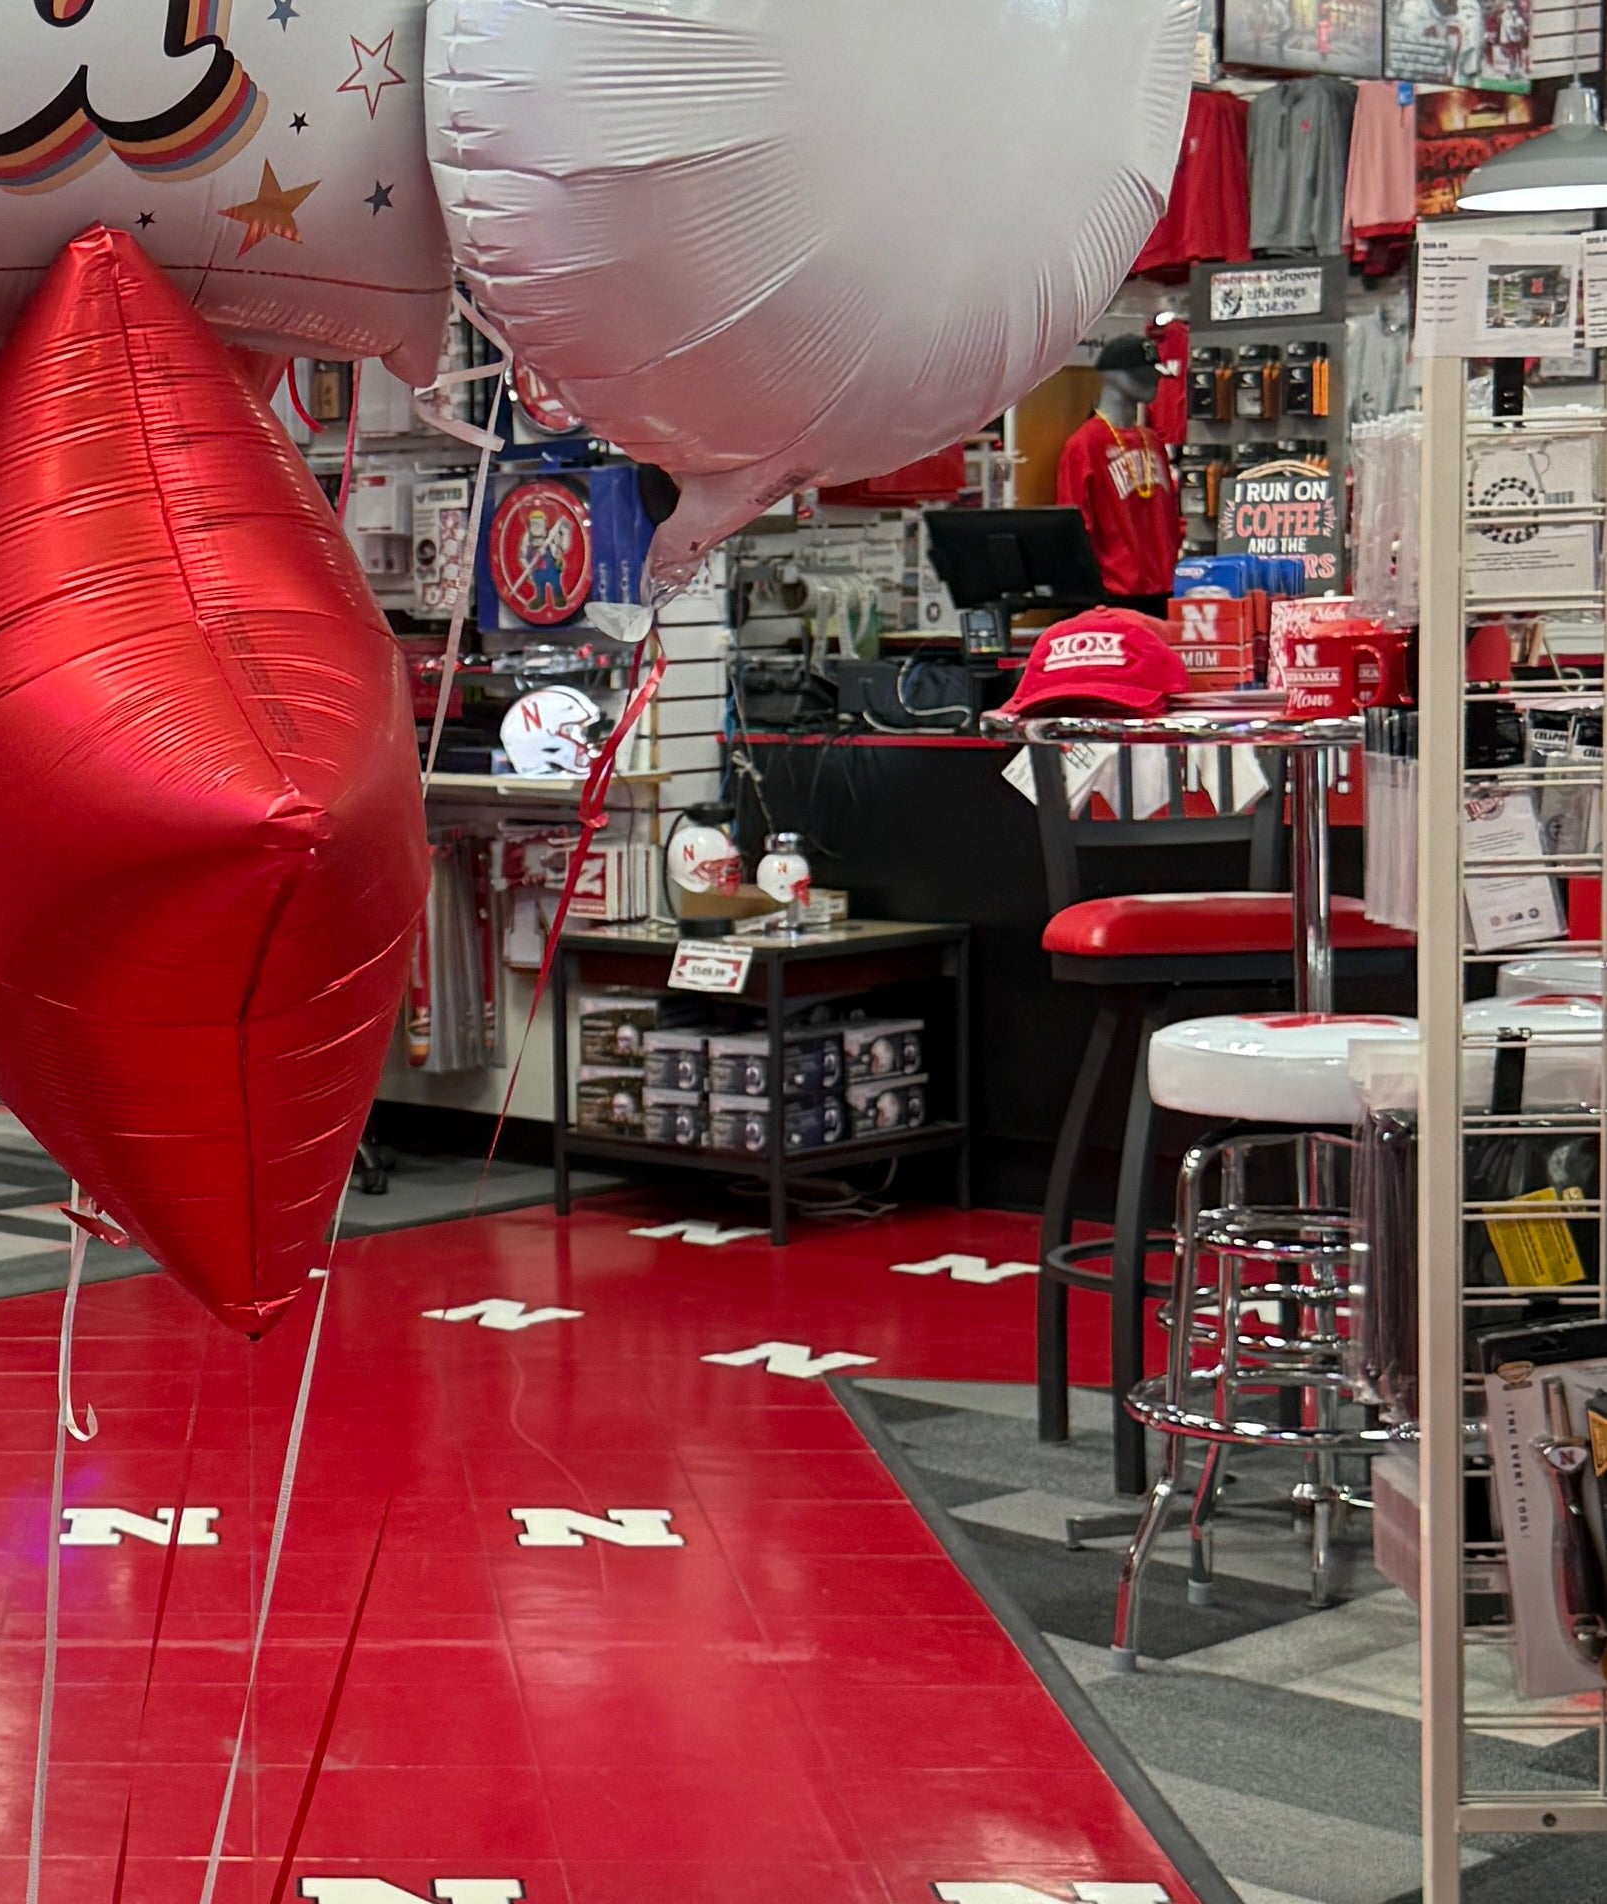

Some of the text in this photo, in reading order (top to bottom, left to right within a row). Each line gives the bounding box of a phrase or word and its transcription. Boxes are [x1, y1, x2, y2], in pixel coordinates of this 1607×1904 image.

[1235, 481, 1328, 502] I RUN ON
[1235, 502, 1321, 538] COFFEE
[1247, 537, 1307, 554] AND THE
[1181, 604, 1218, 642] N
[1050, 633, 1126, 658] MOM
[1182, 651, 1219, 667] MOM
[1295, 644, 1318, 667] N
[521, 701, 542, 733] N
[58, 1507, 220, 1546] N
[510, 1507, 685, 1548] N
